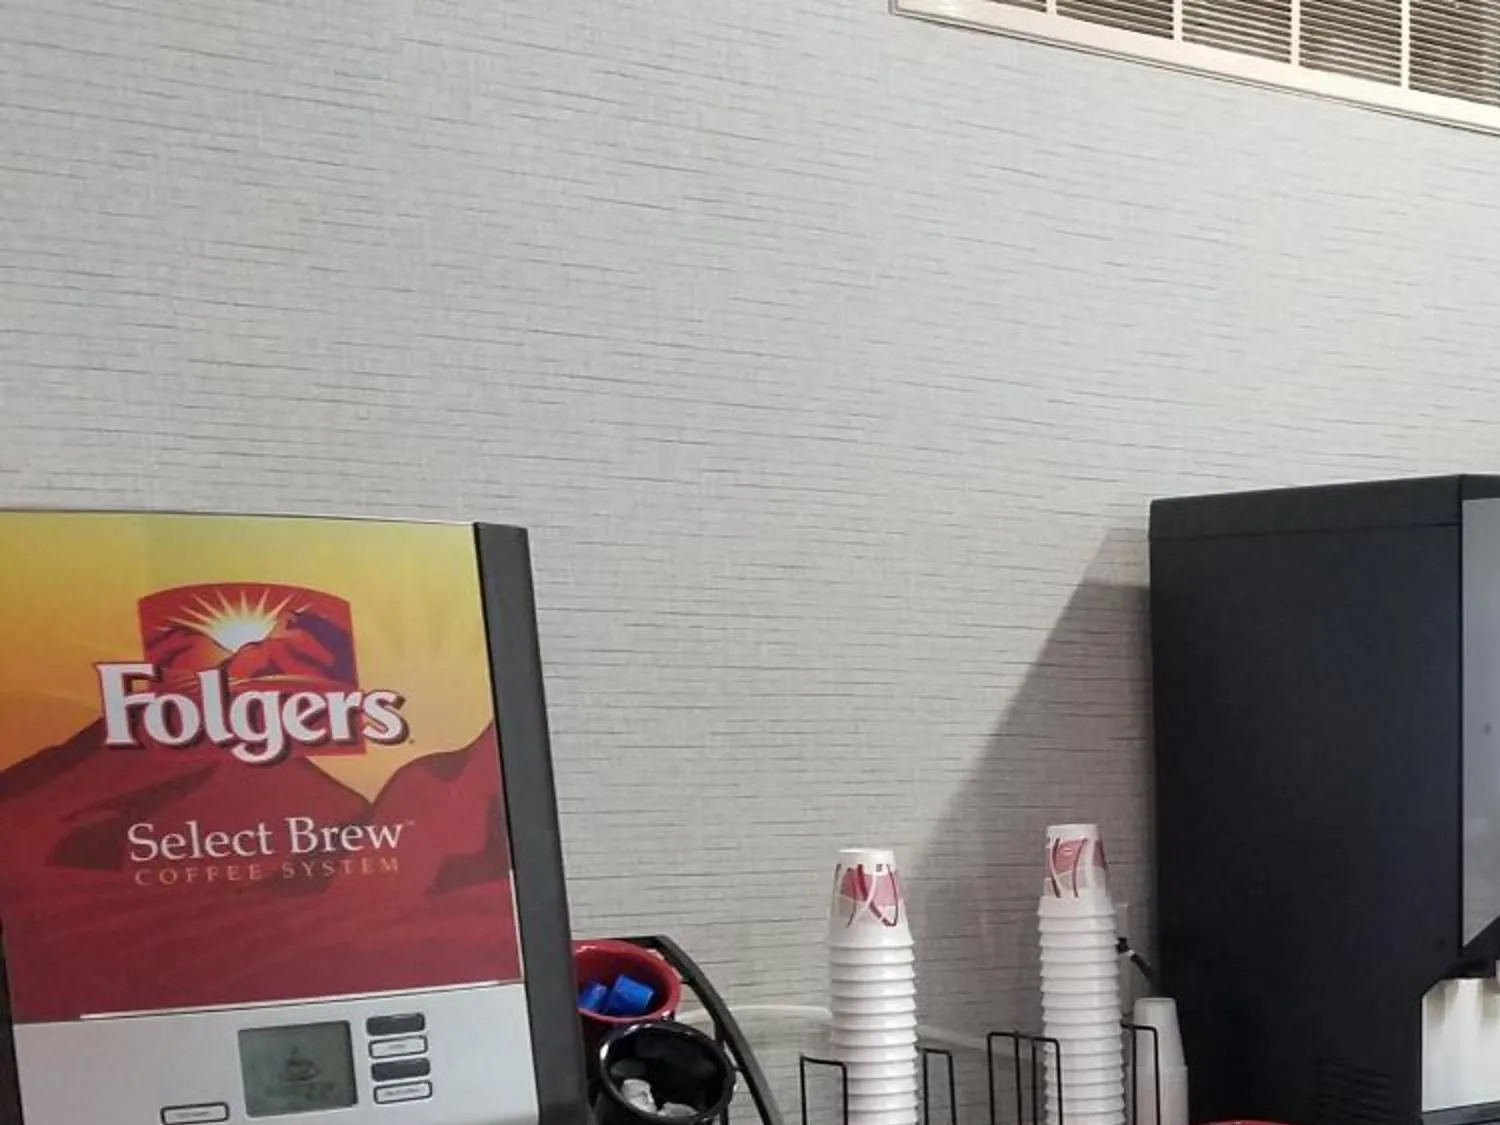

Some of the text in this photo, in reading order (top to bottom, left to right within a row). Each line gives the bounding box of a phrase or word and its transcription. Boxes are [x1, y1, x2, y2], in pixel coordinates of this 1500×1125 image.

[96, 662, 406, 765] Folgers
[127, 815, 403, 862] Select Brew
[134, 857, 400, 886] COFFEE SYSTEM
